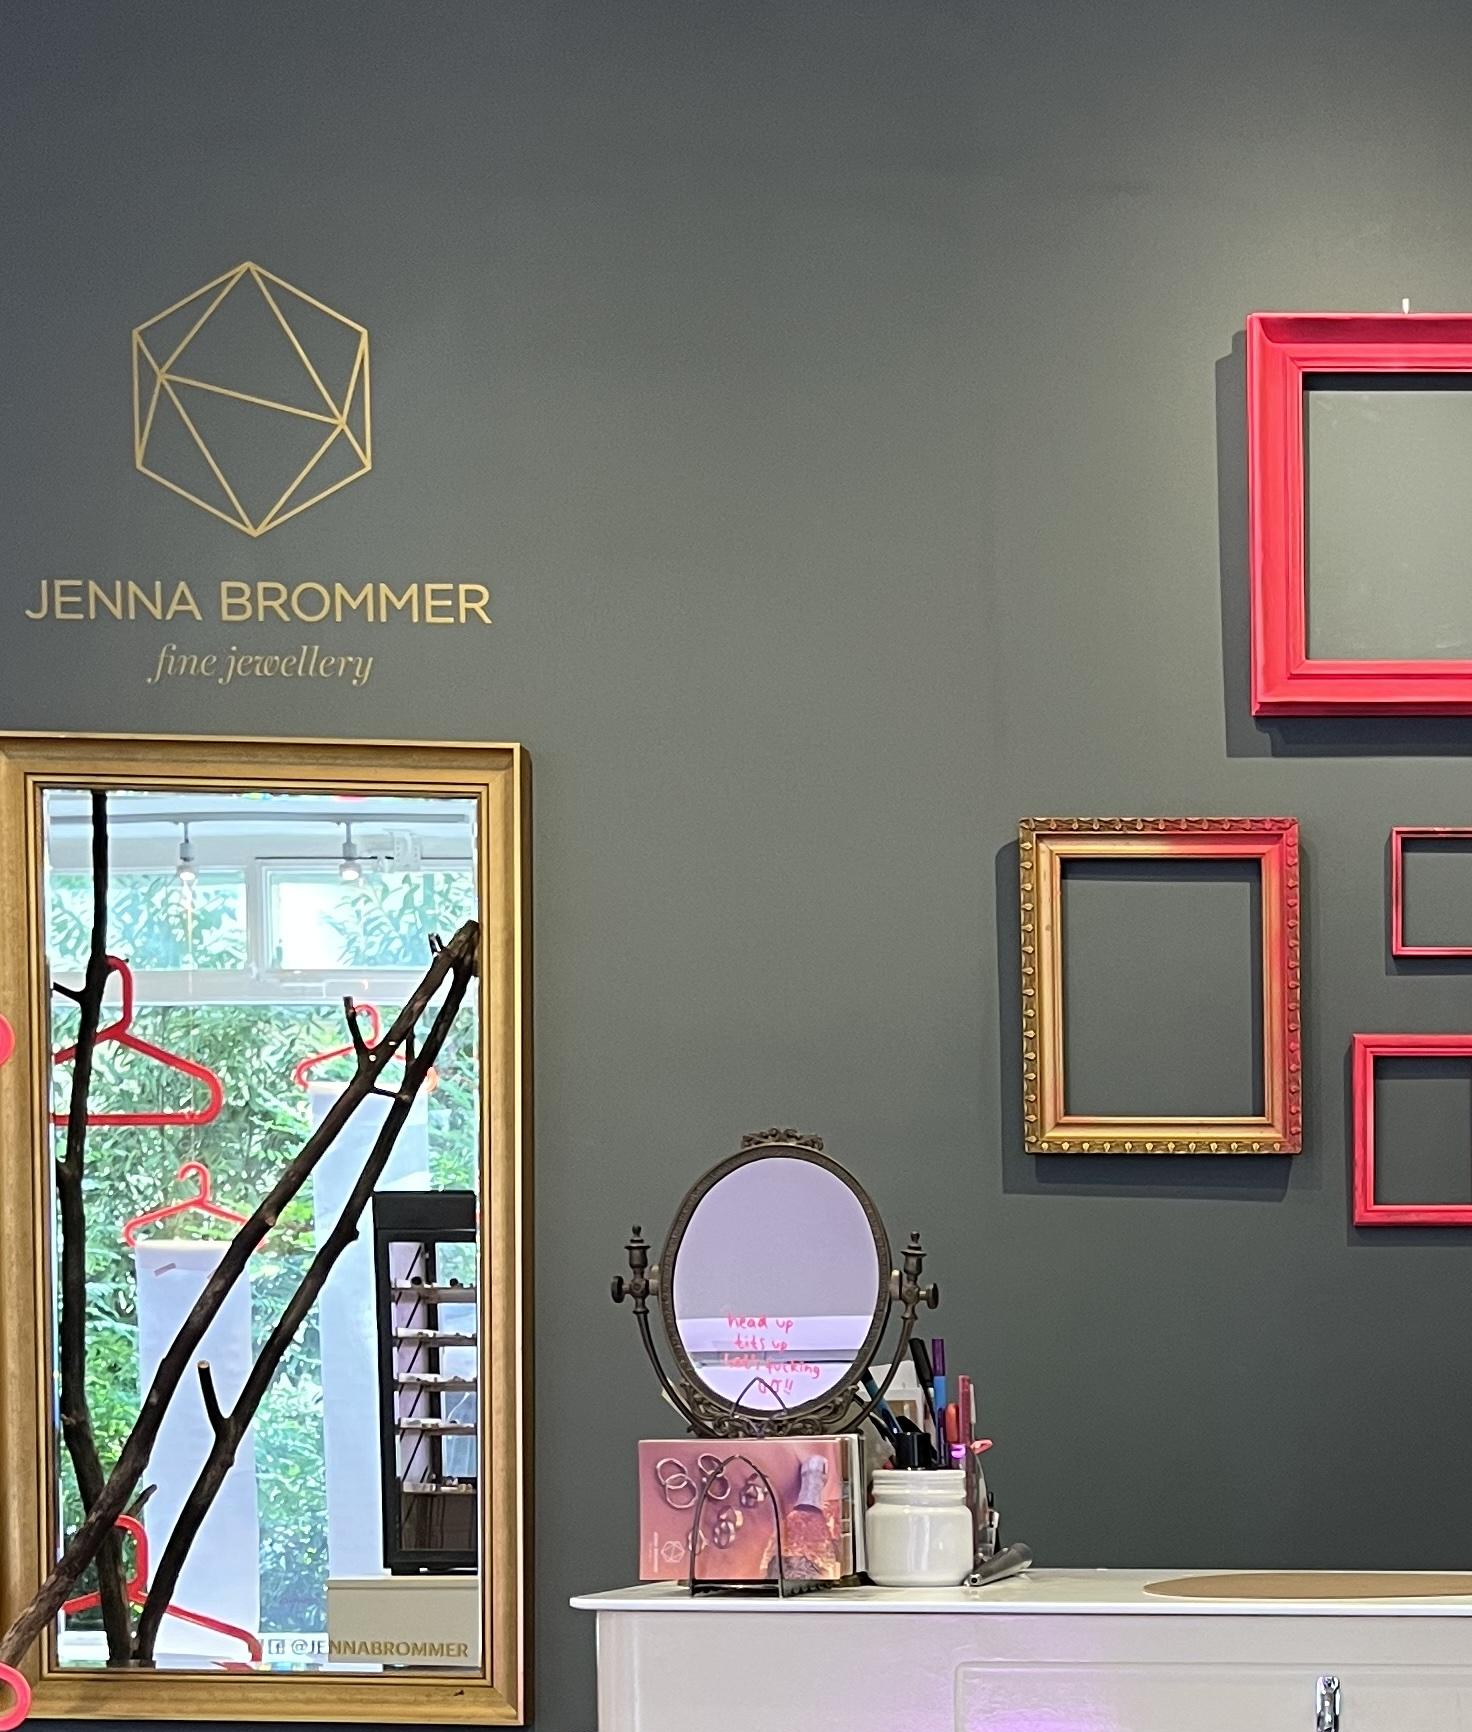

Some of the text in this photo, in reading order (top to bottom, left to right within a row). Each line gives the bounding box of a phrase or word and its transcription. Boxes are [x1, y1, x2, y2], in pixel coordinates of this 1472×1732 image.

[25, 579, 493, 624] JENNA BROMMER
[146, 643, 374, 686] fine jewellery
[727, 1312, 794, 1334] head up
[734, 1333, 788, 1354] tits up
[766, 1356, 820, 1379] fucking
[291, 1638, 468, 1658] @JENNABROMMER
